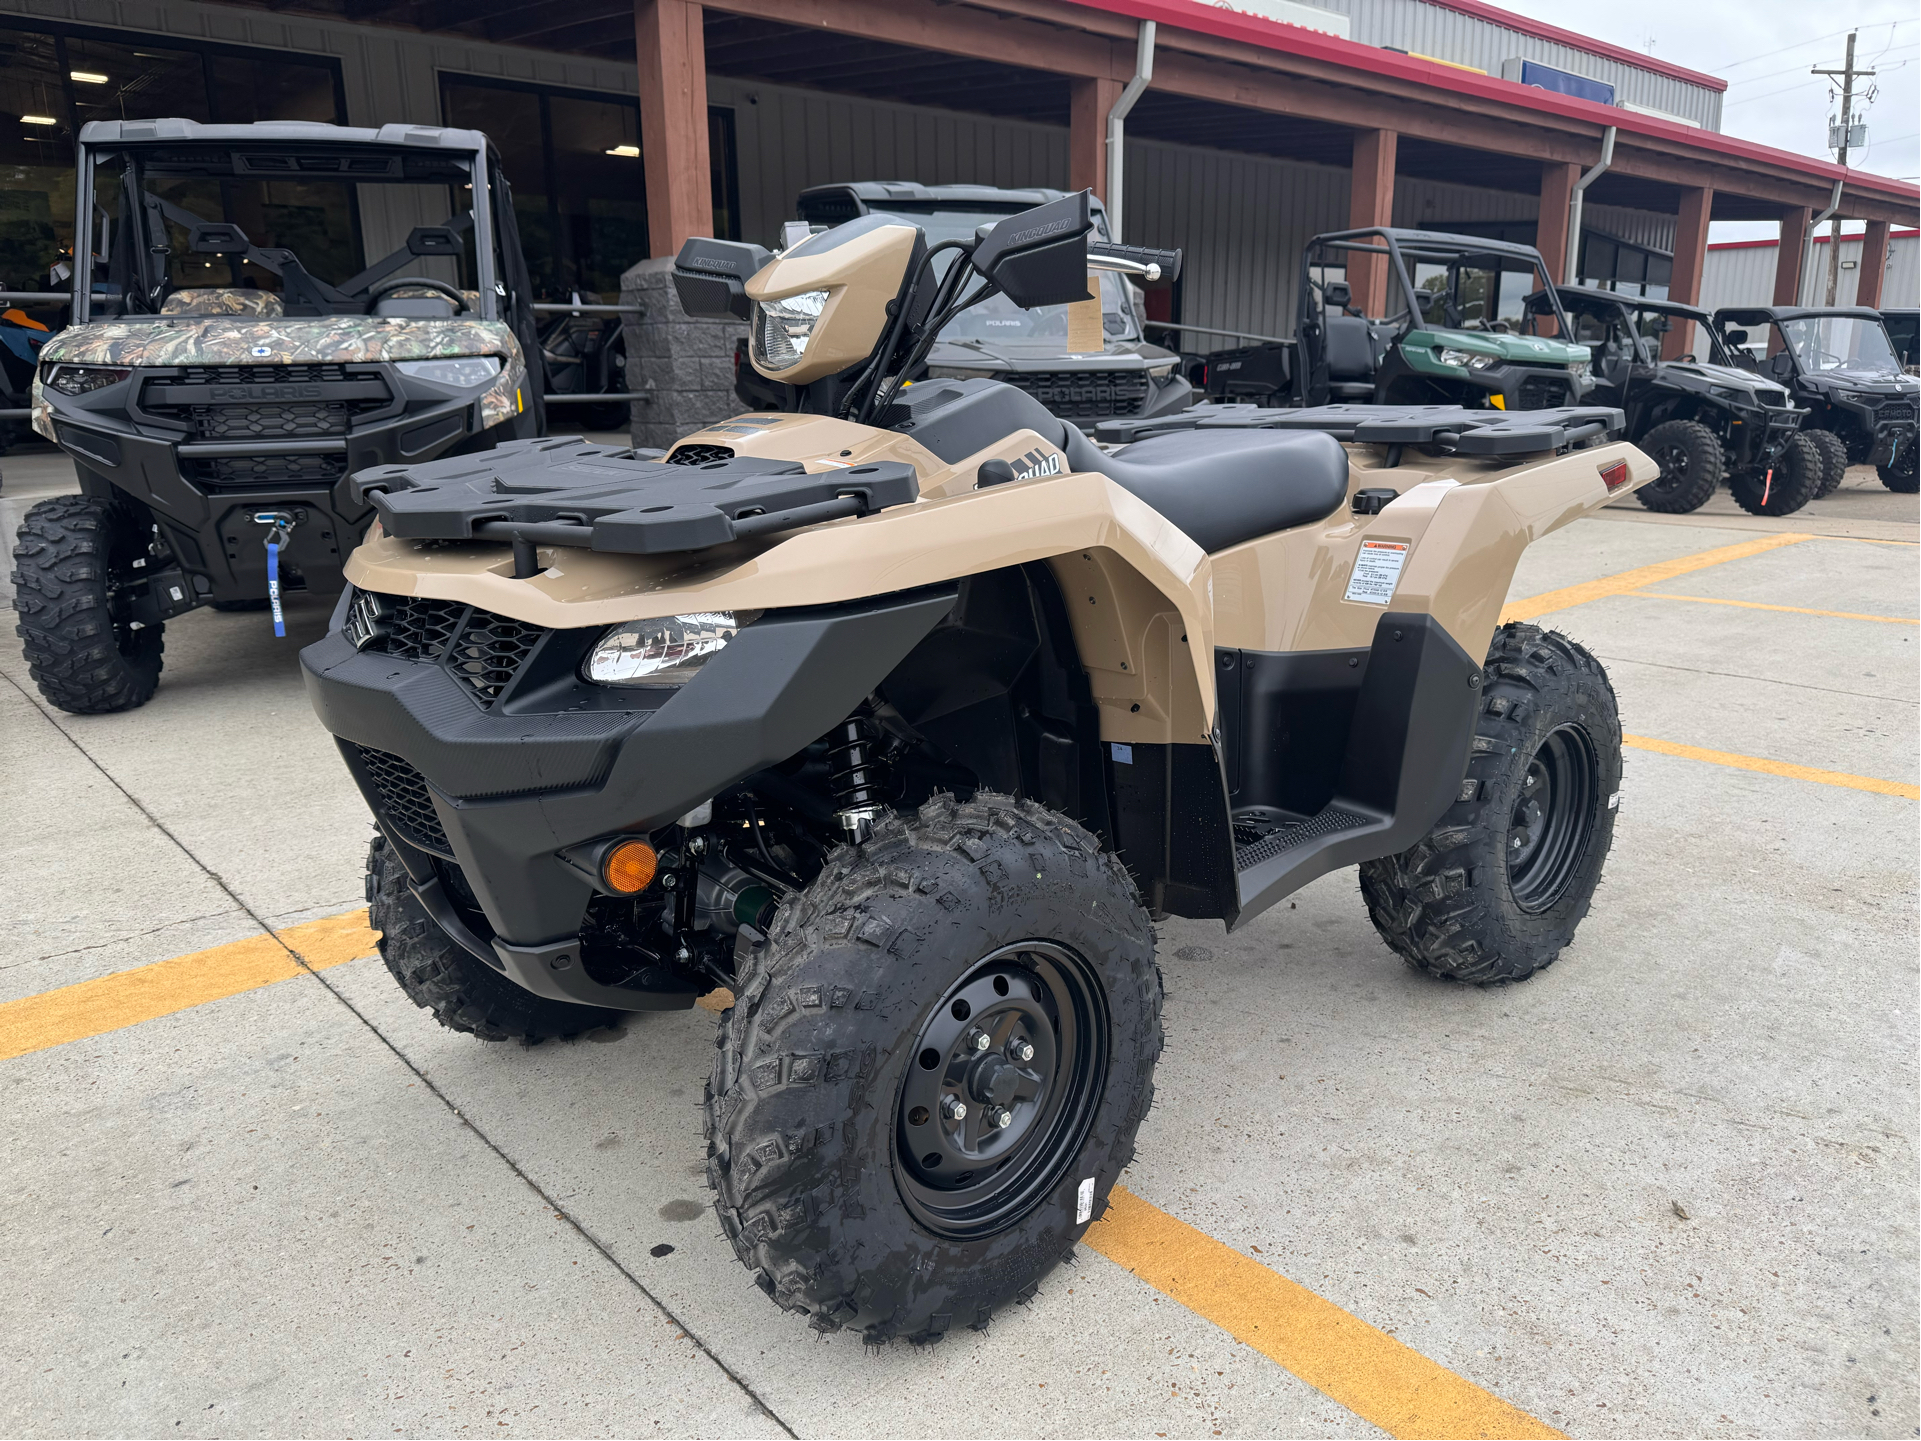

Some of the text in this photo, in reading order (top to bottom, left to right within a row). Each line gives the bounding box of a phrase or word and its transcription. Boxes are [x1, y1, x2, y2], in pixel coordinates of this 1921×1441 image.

[1008, 217, 1071, 245] KINGQUAD
[692, 257, 737, 270] KINGQUAD
[209, 385, 322, 400] POLARIS
[1037, 386, 1129, 402] POLARIS
[269, 580, 283, 623] POLARIS
